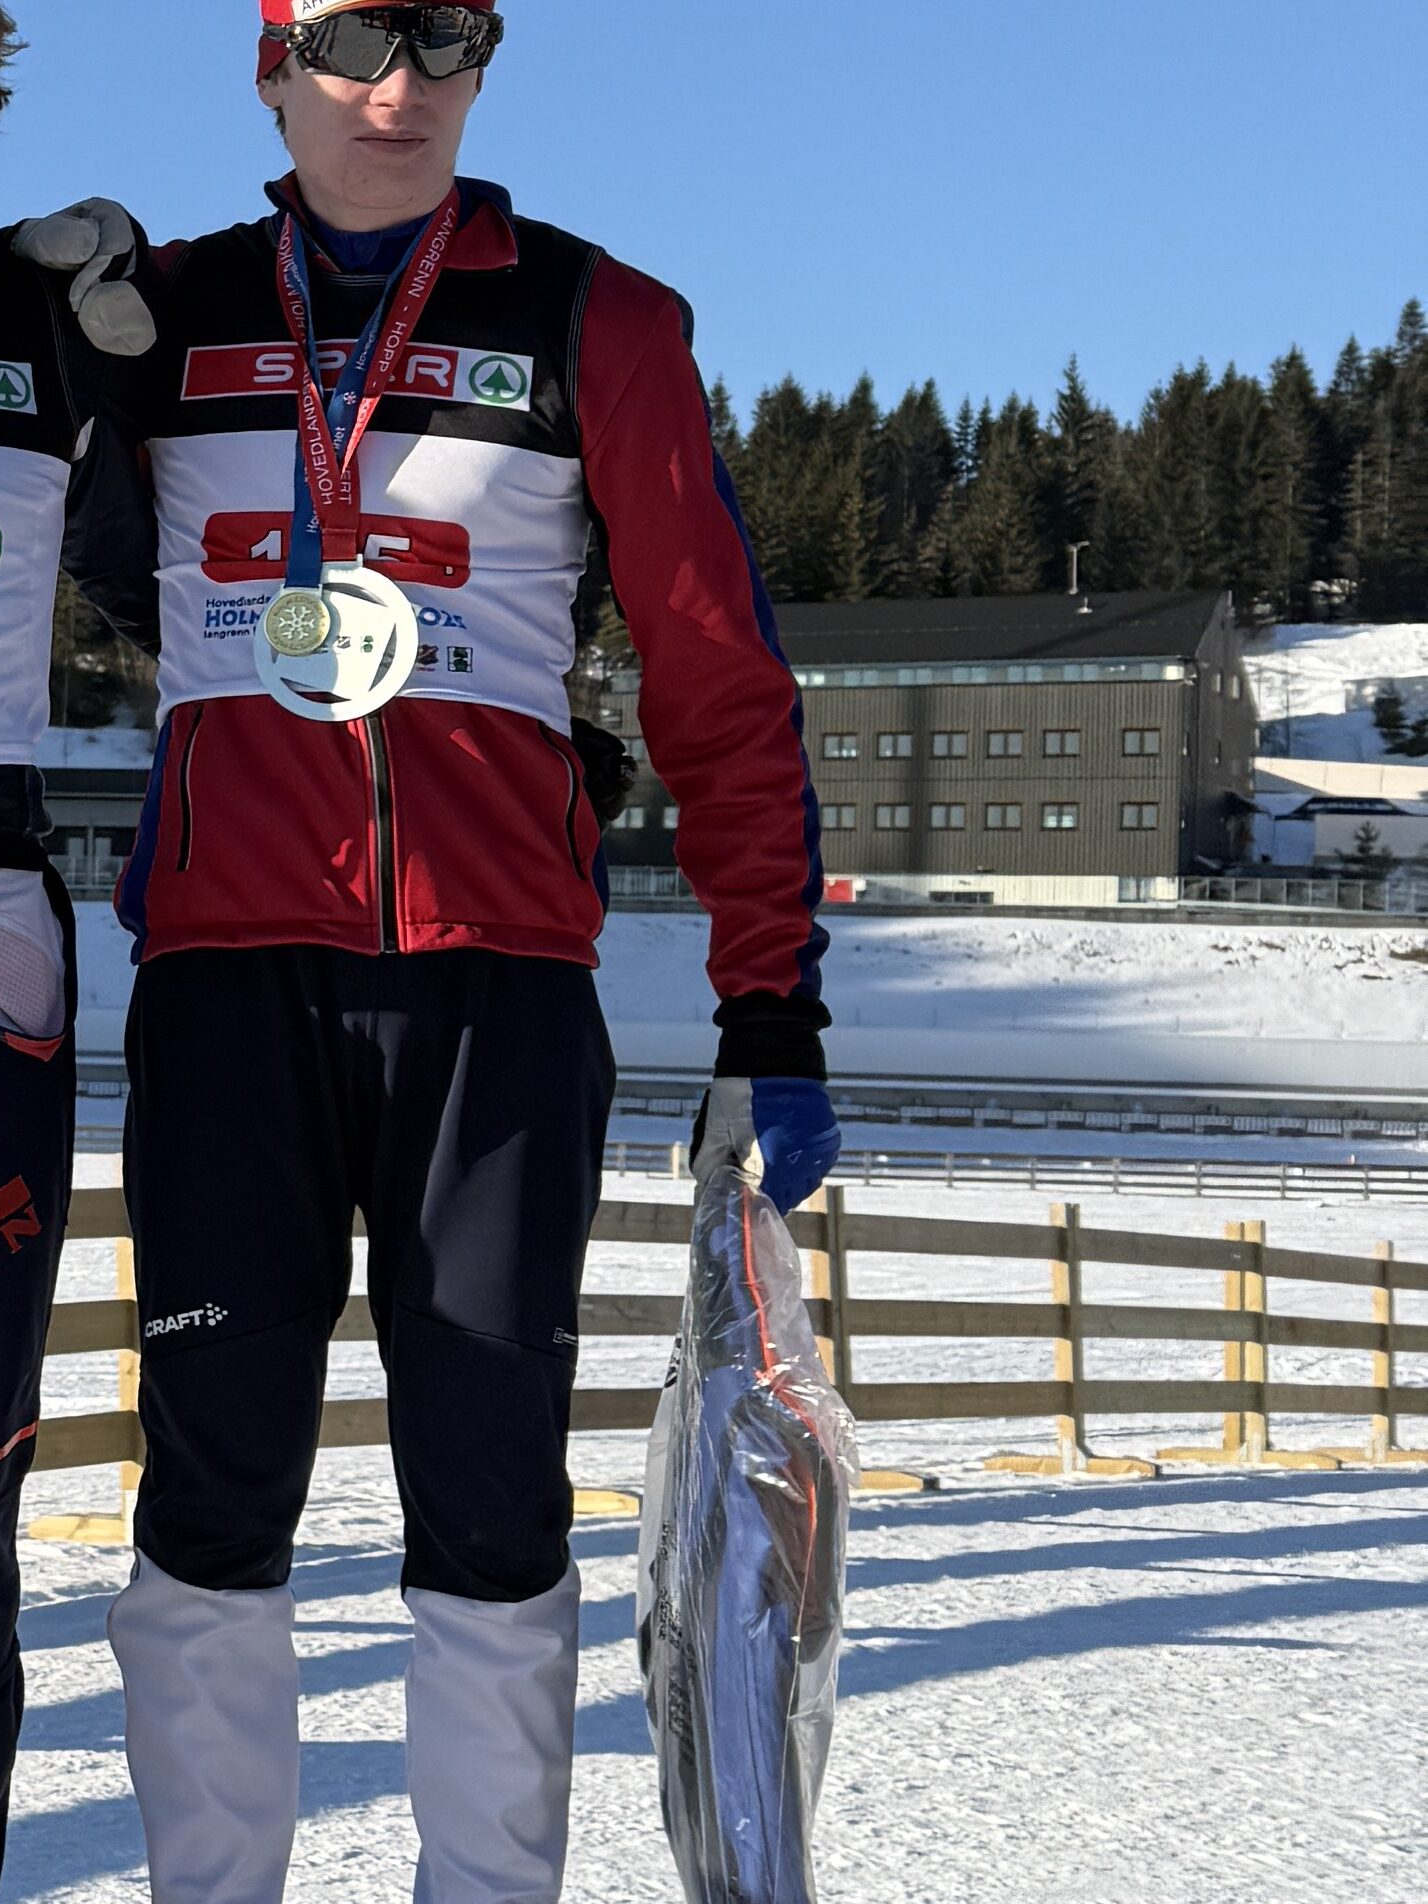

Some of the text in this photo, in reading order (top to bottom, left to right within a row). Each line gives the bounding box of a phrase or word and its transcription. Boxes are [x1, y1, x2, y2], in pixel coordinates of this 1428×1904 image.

[408, 207, 456, 298] LANGRENN
[252, 349, 452, 388] SPR
[380, 321, 407, 373] HOPP
[144, 1306, 206, 1339] CRAFT
